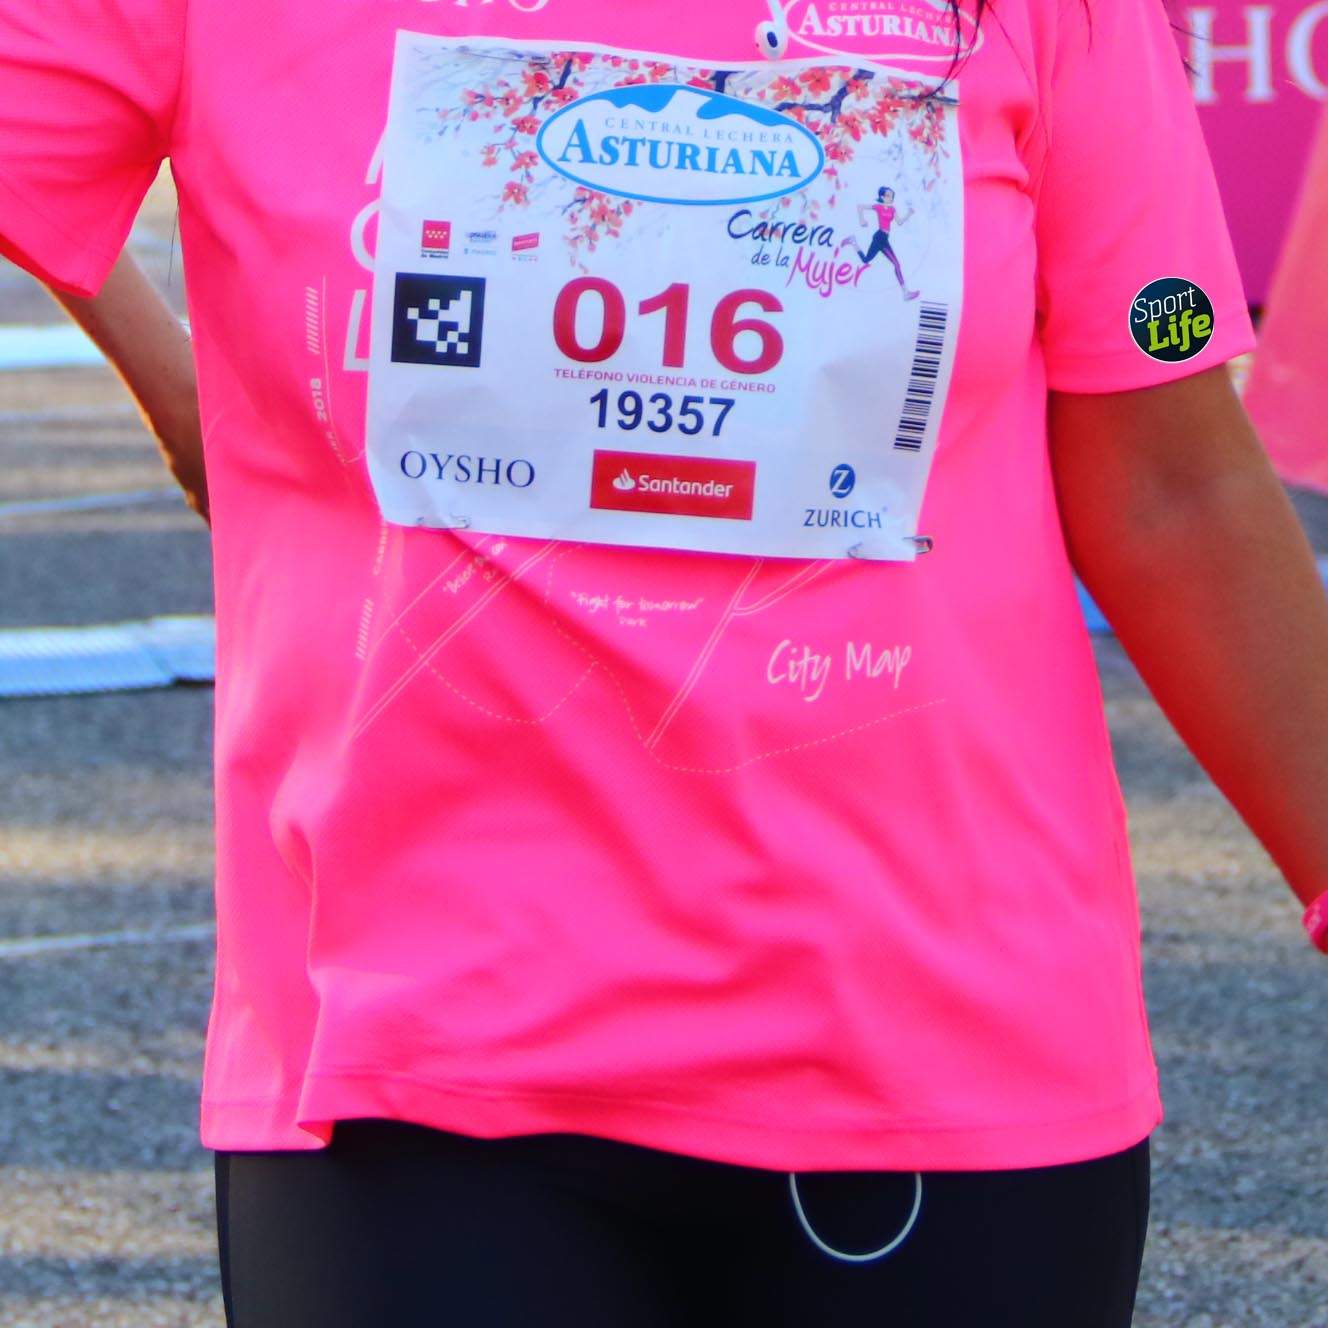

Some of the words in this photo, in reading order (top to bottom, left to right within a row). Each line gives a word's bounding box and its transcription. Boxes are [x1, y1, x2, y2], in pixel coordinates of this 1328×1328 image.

[798, 3, 968, 49] ASTURIANA
[558, 118, 803, 179] ASTURIANA
[604, 116, 695, 137] CENTRAL
[703, 127, 795, 144] LECHERA
[726, 208, 835, 249] Carrera
[750, 248, 772, 267] de
[774, 248, 789, 269] la
[785, 245, 871, 299] Mujer
[552, 275, 786, 376] 016
[1133, 286, 1197, 324] Sport
[1147, 309, 1213, 352] Life
[553, 367, 624, 383] TELÉFONO
[626, 373, 698, 389] VIOLENCIA
[699, 378, 718, 390] DE
[720, 377, 777, 393] GÉNERO
[588, 387, 736, 438] 19357
[399, 449, 536, 489] OYSHO
[637, 473, 735, 500] Santander
[803, 507, 882, 530] ZURICH
[766, 638, 832, 703] City
[845, 640, 913, 690] Map
